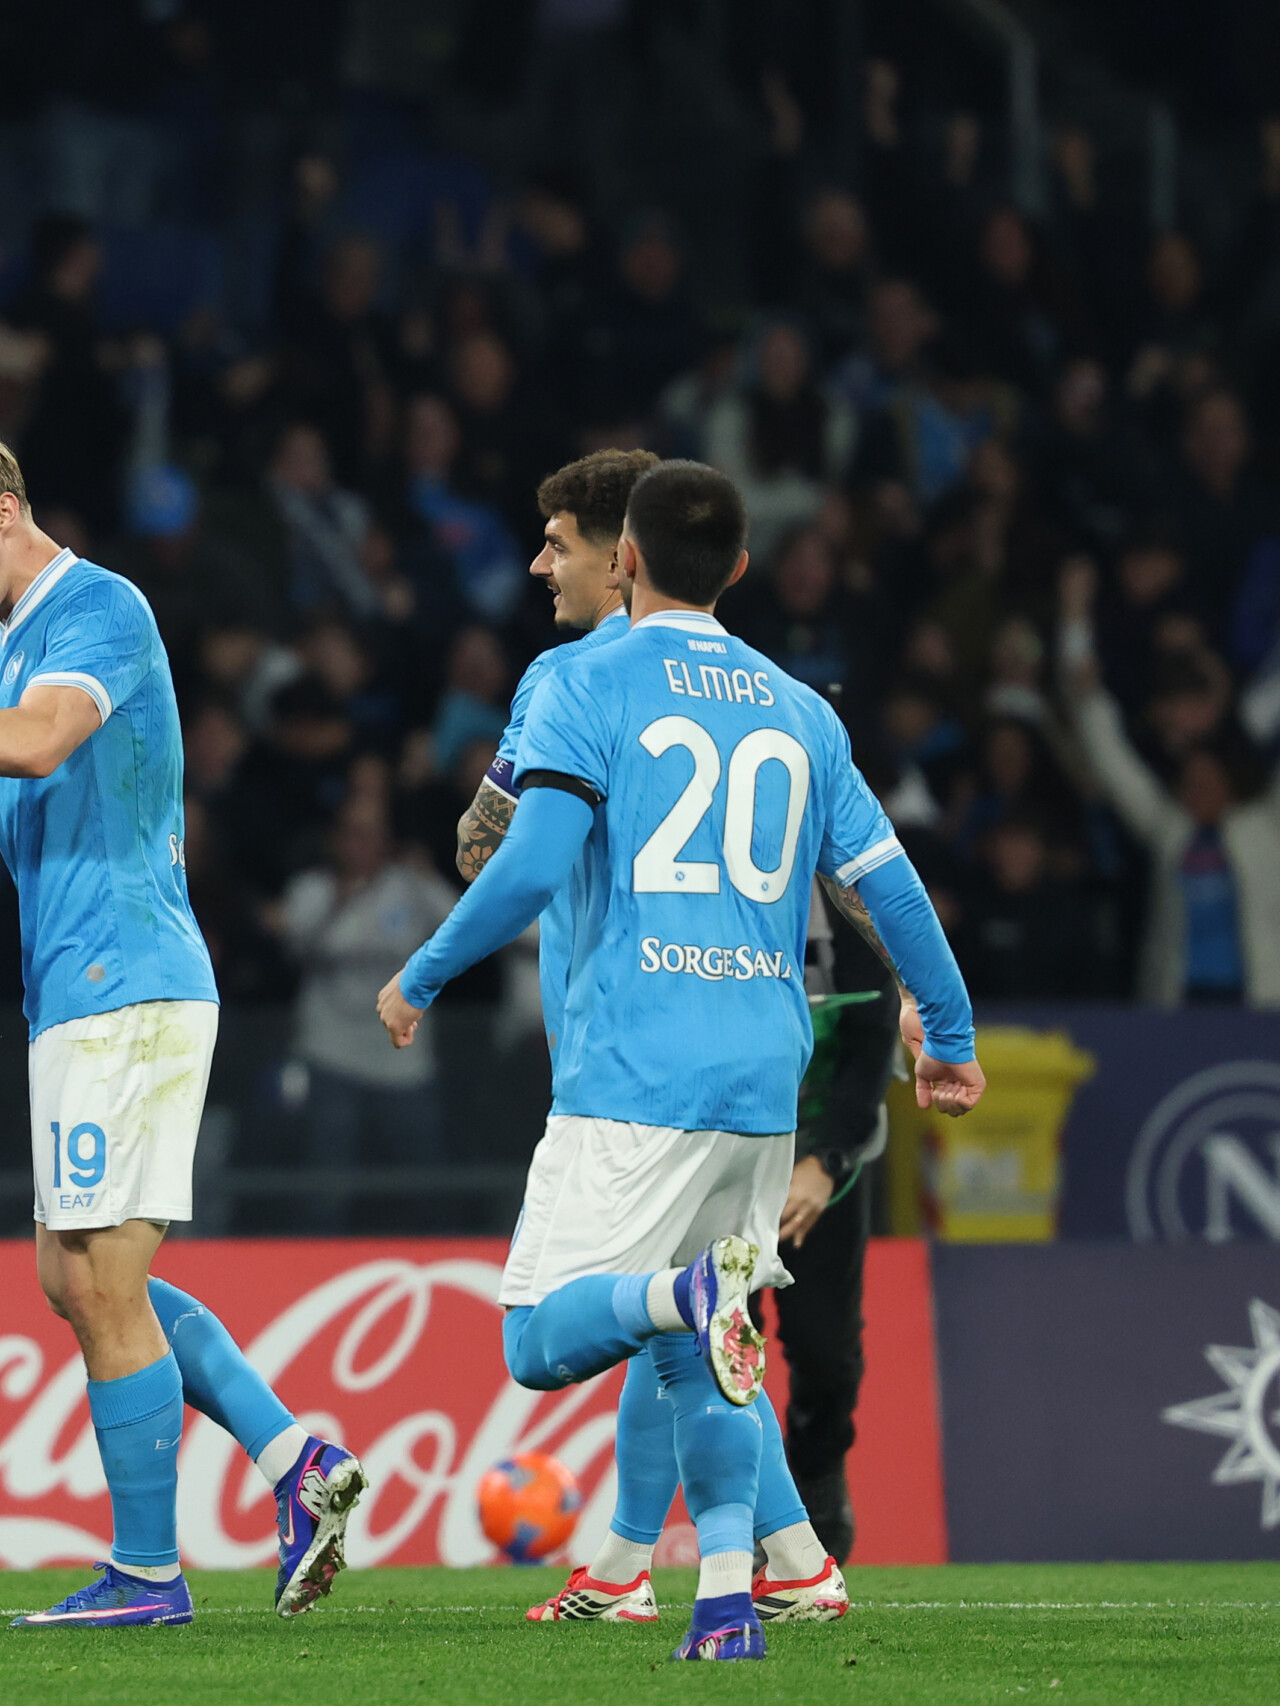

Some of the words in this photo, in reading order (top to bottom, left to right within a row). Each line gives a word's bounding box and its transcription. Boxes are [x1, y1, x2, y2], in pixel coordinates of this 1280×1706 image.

[662, 658, 775, 708] ELMAS
[632, 714, 811, 904] 20
[50, 1121, 107, 1188] 19
[59, 1192, 96, 1209] EA7
